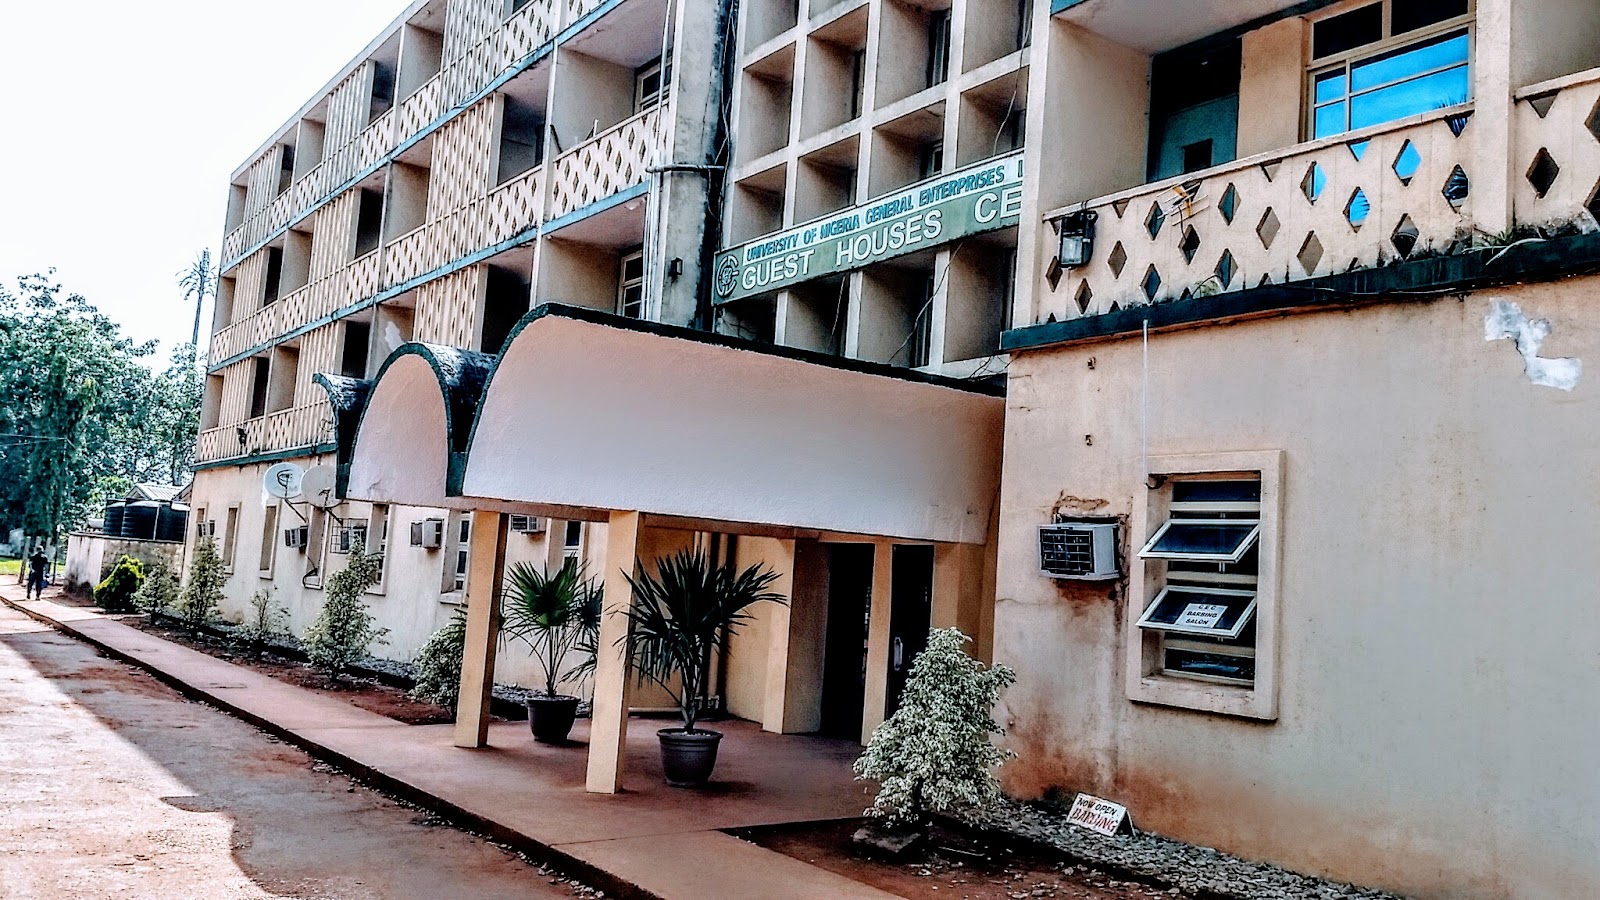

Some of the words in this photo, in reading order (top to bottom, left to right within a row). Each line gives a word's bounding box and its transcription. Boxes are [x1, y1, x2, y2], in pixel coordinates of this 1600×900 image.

[742, 249, 816, 290] GUEST
[836, 209, 943, 267] HOUSES
[747, 233, 800, 261] UNIVERSITY
[803, 227, 818, 245] OF
[820, 214, 861, 239] NIGERIA
[865, 194, 915, 224] GENERAL
[919, 165, 1005, 207] ENTERPRISES
[1077, 797, 1096, 809] NOW
[1095, 803, 1118, 816] OPEN
